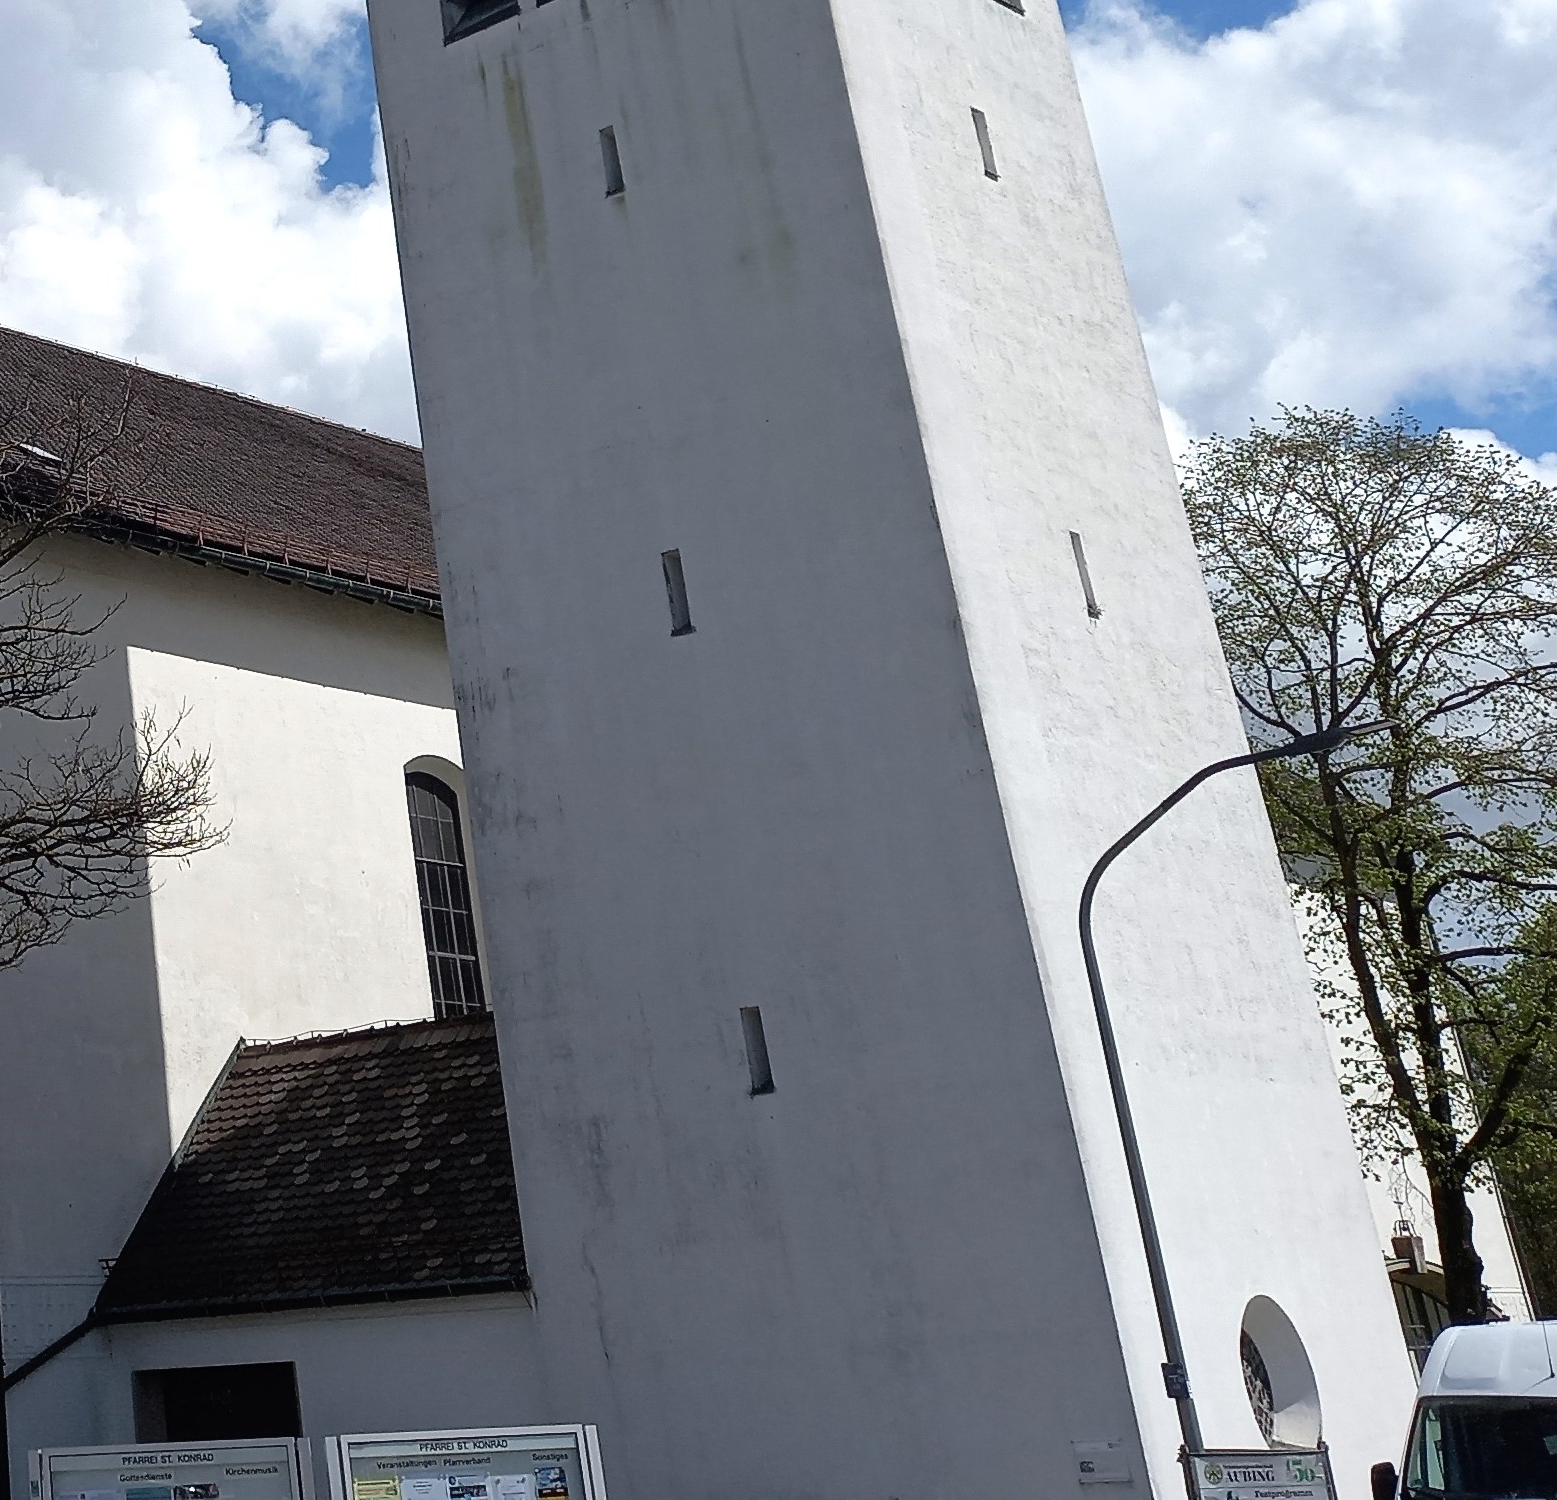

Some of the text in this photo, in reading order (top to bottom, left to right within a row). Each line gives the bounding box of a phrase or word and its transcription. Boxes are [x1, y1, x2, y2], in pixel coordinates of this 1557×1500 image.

[419, 1443, 455, 1452] PFARREI
[473, 1440, 508, 1450] KONRAD
[122, 1453, 214, 1465] PFARREI ST. KONRAD
[443, 1457, 491, 1467] Pfarrverband
[532, 1453, 568, 1462] Sonstiges
[376, 1459, 437, 1470] Veranstaltungen
[225, 1466, 278, 1476] Kirchenmusik
[119, 1473, 172, 1482] Gottesdienste
[1226, 1470, 1275, 1483] AUBING
